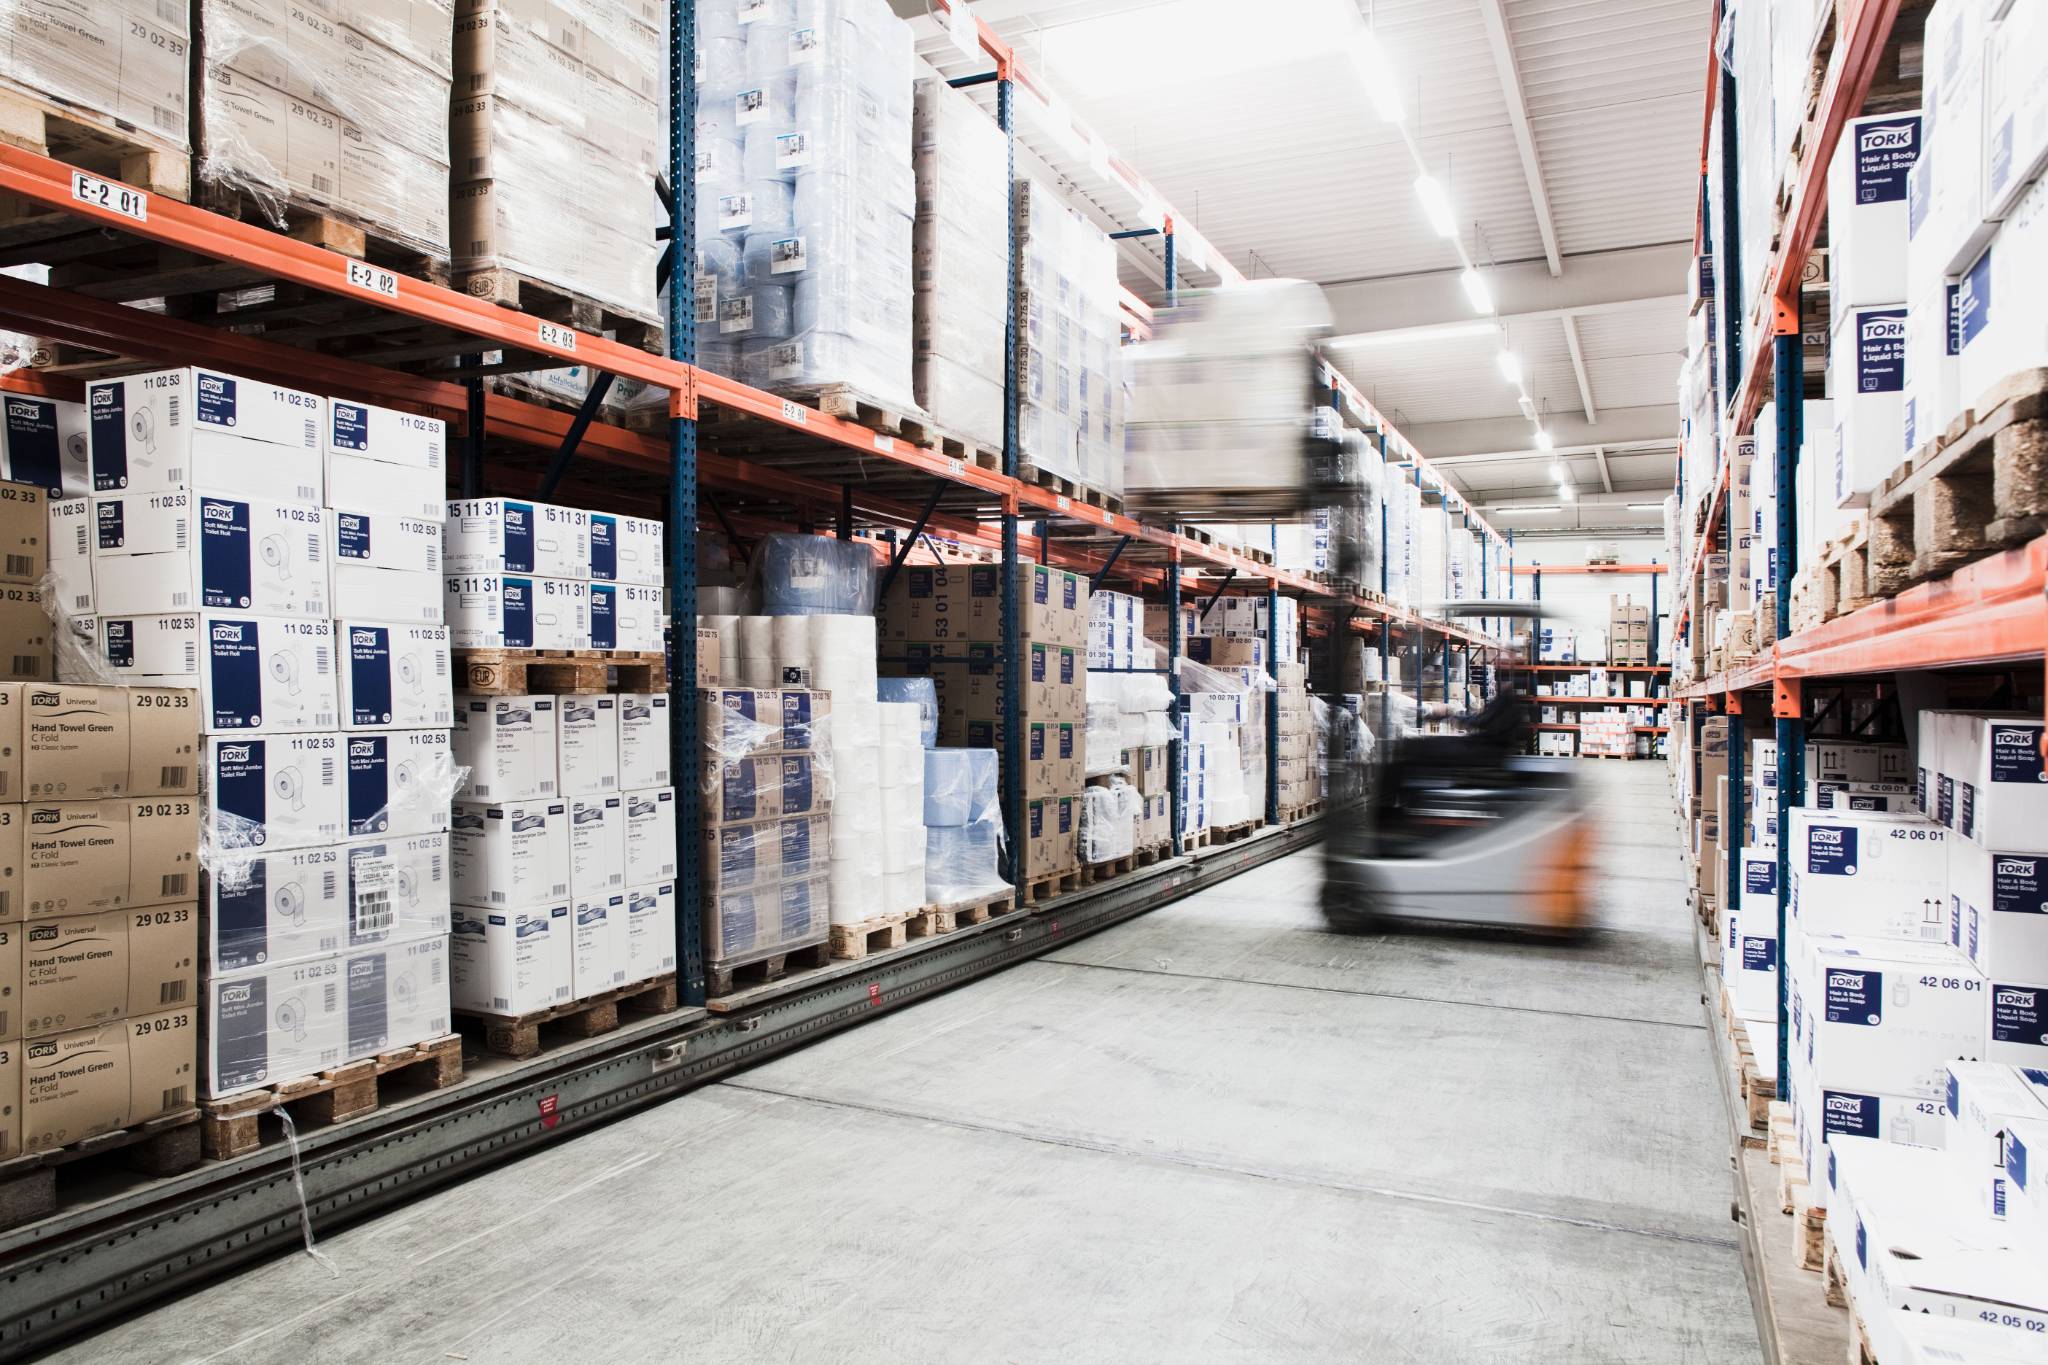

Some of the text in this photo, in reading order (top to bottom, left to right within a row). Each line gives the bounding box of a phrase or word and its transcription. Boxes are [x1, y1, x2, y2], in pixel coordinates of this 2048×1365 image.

[292, 8, 334, 37] 29 02 33
[131, 23, 183, 56] 29 02 33
[292, 103, 332, 129] 29 02 33
[1864, 132, 1909, 148] TORK
[1862, 155, 1880, 163] Hair
[1892, 152, 1916, 160] Body
[1862, 163, 1890, 173] Liquid
[1862, 177, 1892, 185] Premium
[79, 176, 139, 215] E-2 01
[351, 264, 394, 293] E-2 02
[541, 325, 573, 348] E-2 03
[144, 375, 180, 389] 11 02 53
[202, 382, 222, 392] TORK
[273, 392, 317, 409] 11 02 53
[11, 407, 37, 416] TORK
[401, 417, 439, 433] 11 02 53
[2, 489, 36, 503] 02 33
[151, 496, 186, 508] 11 02 53
[206, 508, 231, 519] TORK
[448, 502, 498, 517] 15 11 31
[276, 509, 320, 523] 11 02 53
[545, 508, 585, 525] 15 11 31
[626, 521, 635, 533] 15
[639, 523, 648, 534] 11
[936, 568, 948, 638] 53 01 04
[215, 630, 240, 639] TORK
[284, 624, 328, 635] 11 02 53
[475, 670, 489, 682] EUR
[32, 697, 59, 706] TORK
[137, 695, 188, 708] 29 02 33
[704, 692, 716, 702] 75
[32, 724, 56, 732] Hand
[59, 724, 85, 732] Towel
[32, 734, 58, 742] C Fold
[410, 734, 446, 744] 11 02 53
[1998, 734, 2032, 745] TORK
[292, 739, 334, 750] 11 02 53
[351, 745, 371, 754] TORK
[222, 751, 247, 761] TORK
[138, 804, 189, 817] 29 02 33
[32, 813, 97, 823] TORK Universal
[1890, 830, 1943, 841] 42 06 01
[32, 838, 114, 850] Hand Towel Green
[32, 851, 58, 860] C Fold
[1999, 864, 2032, 874] TORK
[136, 910, 188, 927] 29 02 33
[30, 926, 96, 940] TORK Universal
[30, 950, 112, 967] Hand Towel Green
[1832, 978, 1861, 988] TORK
[1920, 976, 1981, 991] 42 06 01
[223, 990, 248, 1000] TORK
[136, 1016, 188, 1035] 29 02 33
[29, 1038, 95, 1058] TORK Universal
[30, 1061, 113, 1085] Hand Towel Green
[1979, 1312, 2045, 1332] 42 05 02
